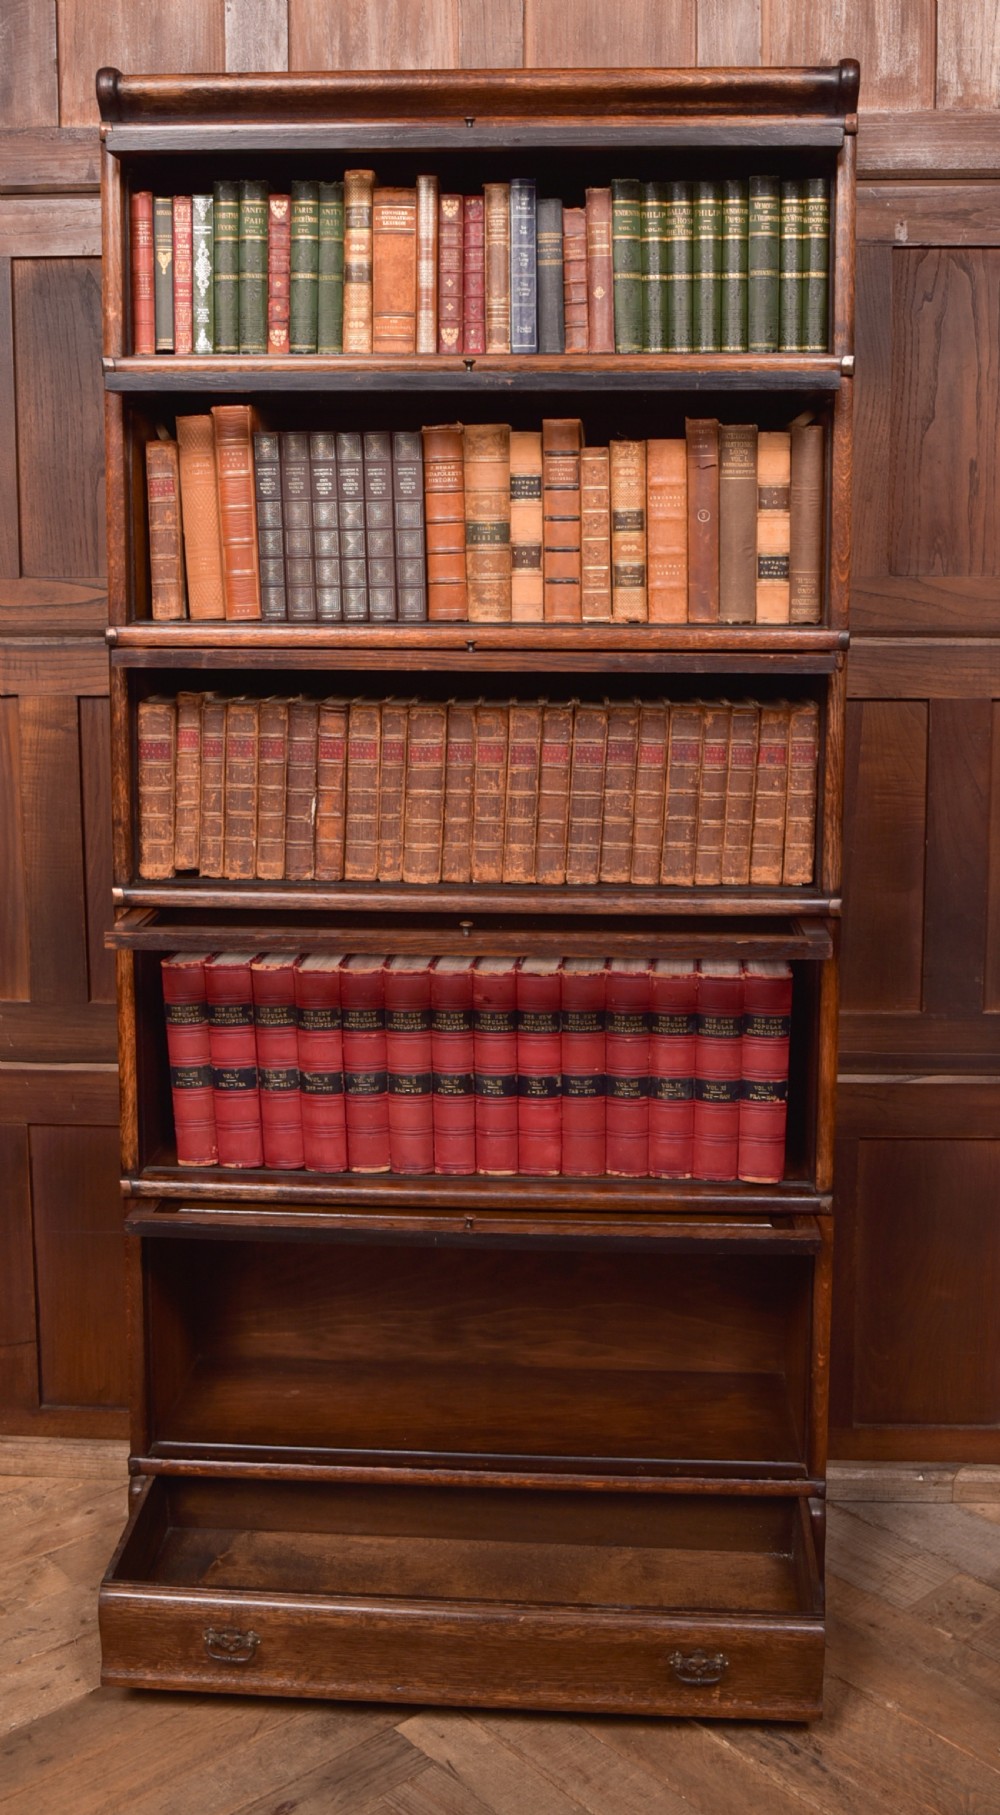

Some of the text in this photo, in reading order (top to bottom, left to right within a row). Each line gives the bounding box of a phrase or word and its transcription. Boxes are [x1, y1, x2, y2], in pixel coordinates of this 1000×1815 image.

[294, 206, 313, 214] PARIS
[695, 209, 720, 217] PHILIP
[641, 211, 666, 219] PHILIP
